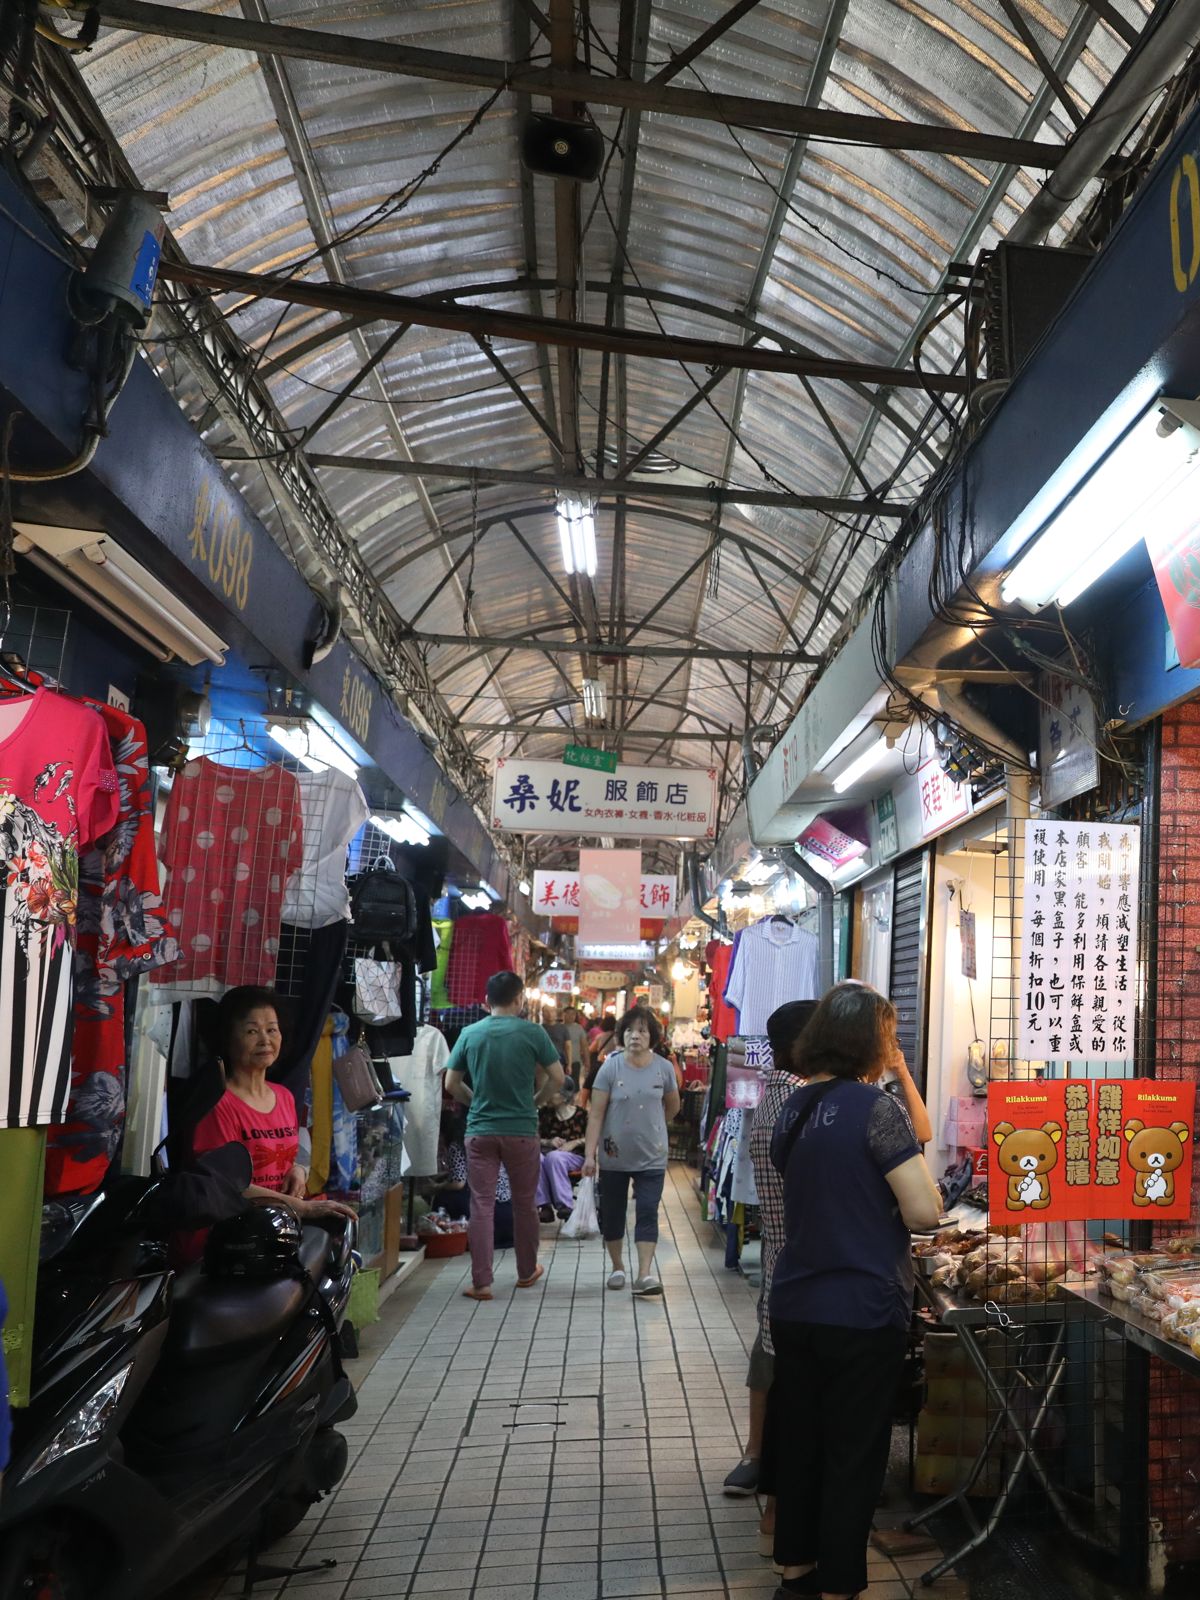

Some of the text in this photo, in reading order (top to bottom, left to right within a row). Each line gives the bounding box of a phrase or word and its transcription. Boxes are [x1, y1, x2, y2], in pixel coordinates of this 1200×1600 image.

[604, 779, 689, 805] 服飾店
[1005, 1095, 1048, 1103] Rilakkuma
[1137, 1093, 1177, 1102] Rilakkuma
[1064, 1084, 1090, 1187] 恭賀新禧
[1094, 1084, 1123, 1187] 雞祥如意
